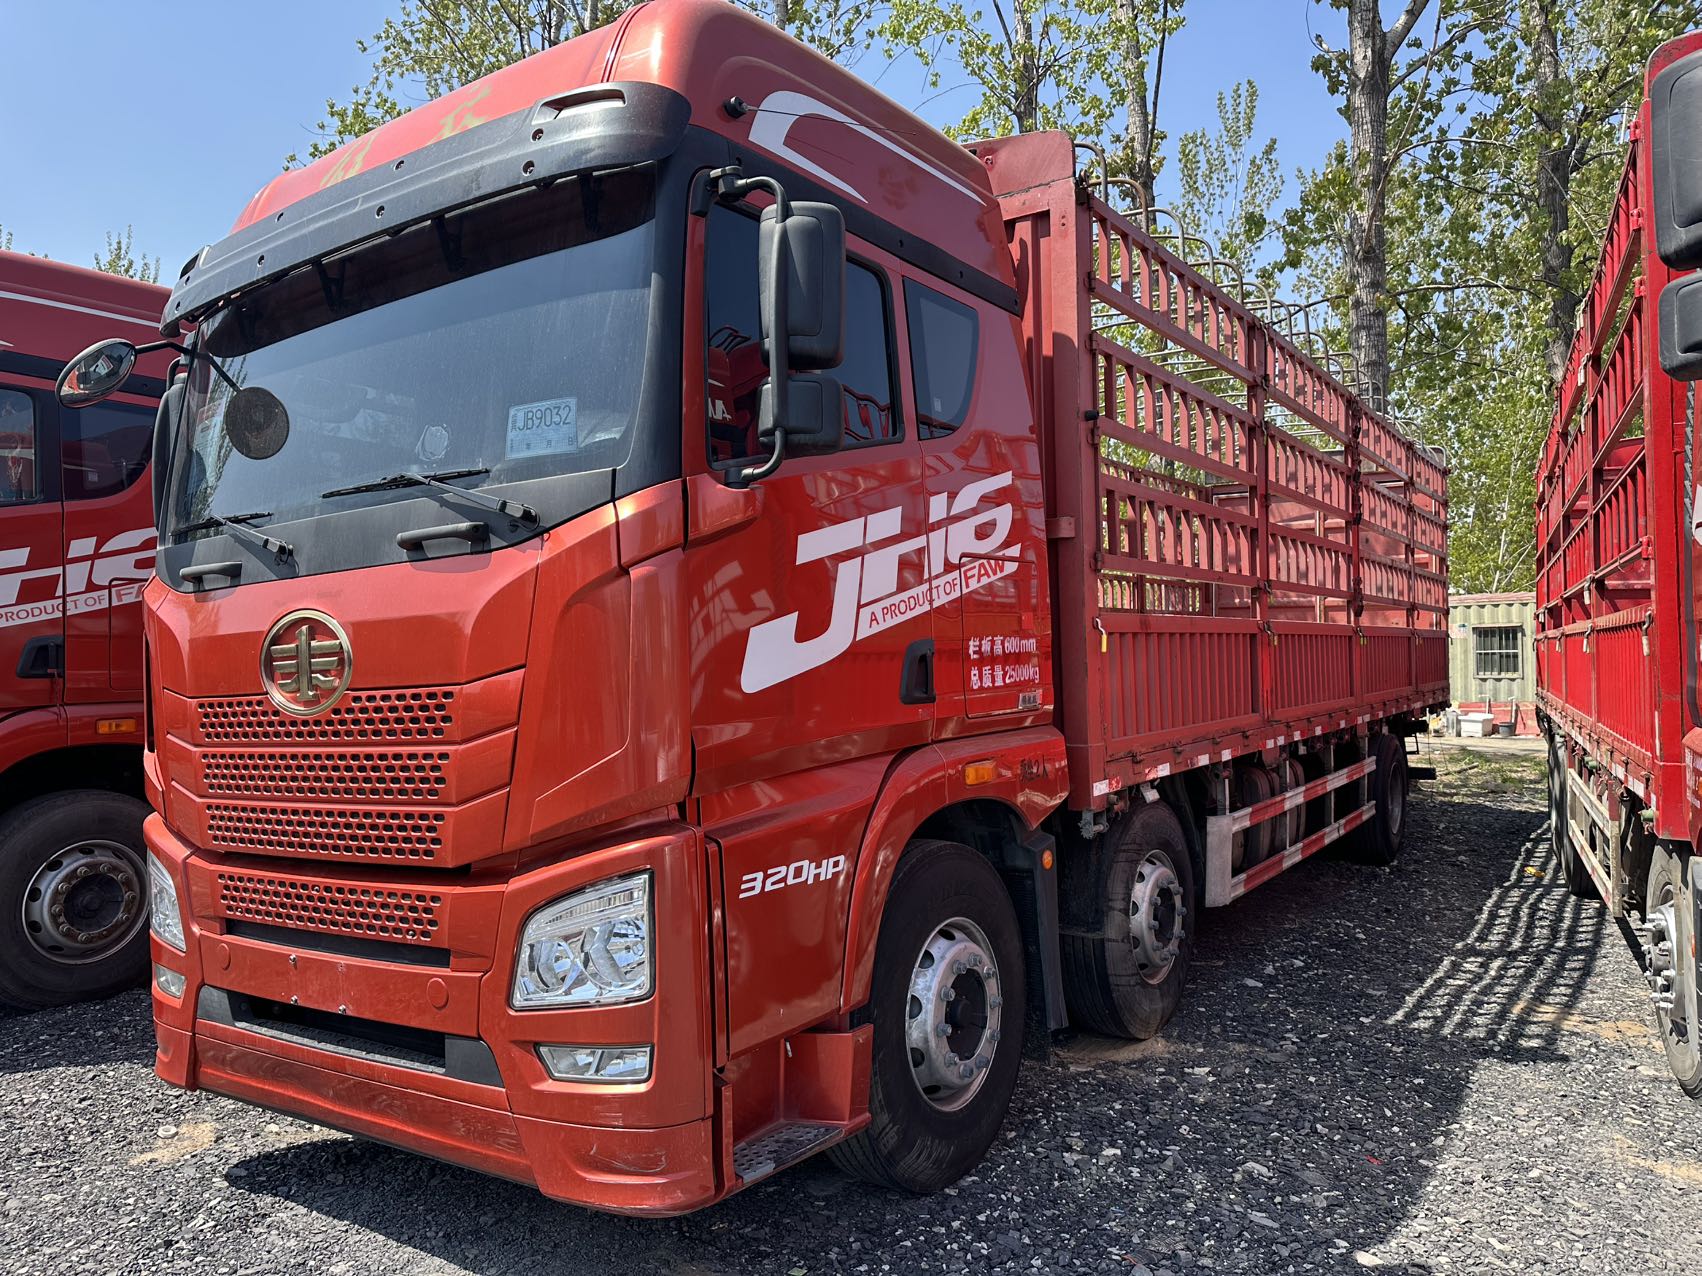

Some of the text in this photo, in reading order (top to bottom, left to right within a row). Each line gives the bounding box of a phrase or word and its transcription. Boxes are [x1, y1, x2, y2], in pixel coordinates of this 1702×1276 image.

[0, 594, 106, 622] RODUCT OF
[741, 470, 1013, 694] JH6
[868, 555, 1006, 629] A PRODUCT OF FAW
[738, 854, 846, 899] 320HP
